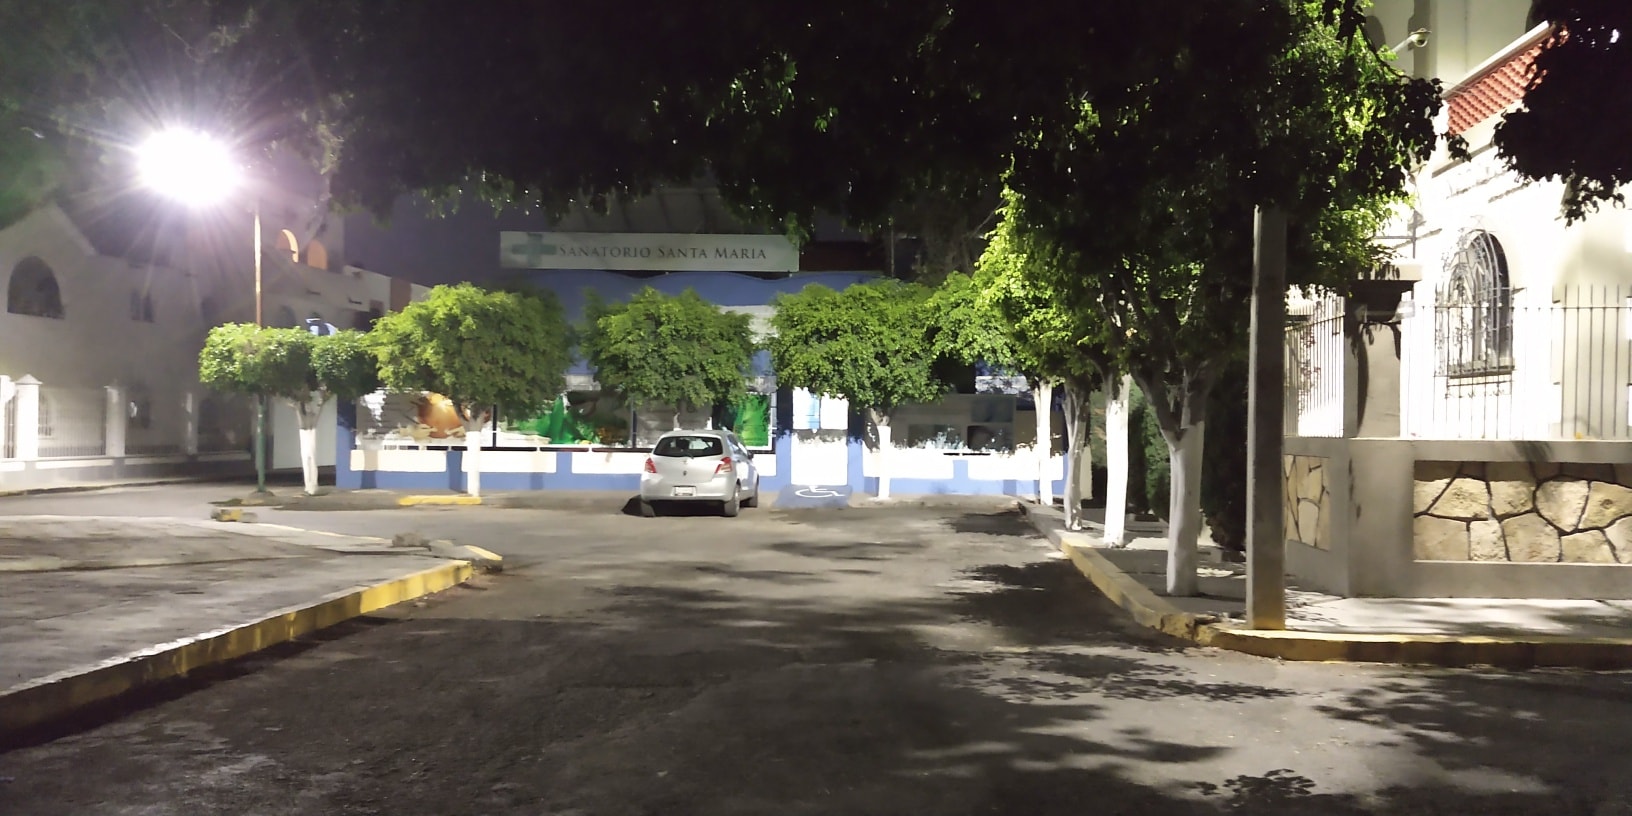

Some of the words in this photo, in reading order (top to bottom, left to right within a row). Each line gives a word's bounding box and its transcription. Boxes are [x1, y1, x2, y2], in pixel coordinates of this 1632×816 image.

[559, 245, 651, 258] SANATORIO
[658, 246, 707, 259] SANTA
[714, 247, 767, 259] MARIA
